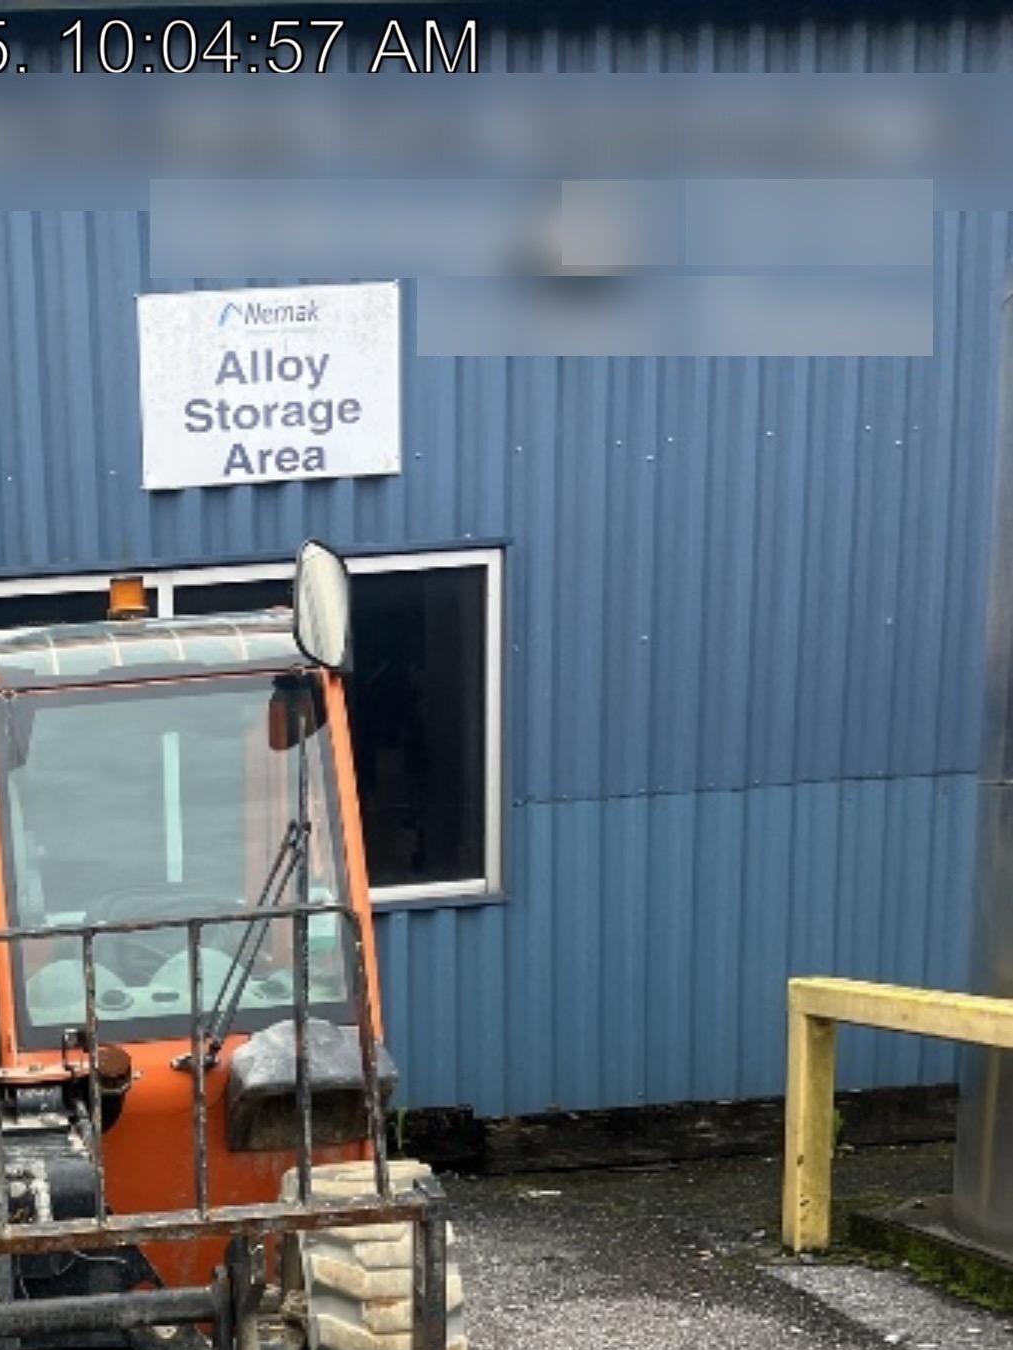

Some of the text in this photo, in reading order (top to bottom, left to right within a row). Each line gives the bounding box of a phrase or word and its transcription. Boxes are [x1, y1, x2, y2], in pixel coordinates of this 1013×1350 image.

[244, 300, 320, 325] Nemak
[215, 349, 330, 390] Alloy
[184, 398, 363, 435] Storage
[223, 443, 326, 476] Area
